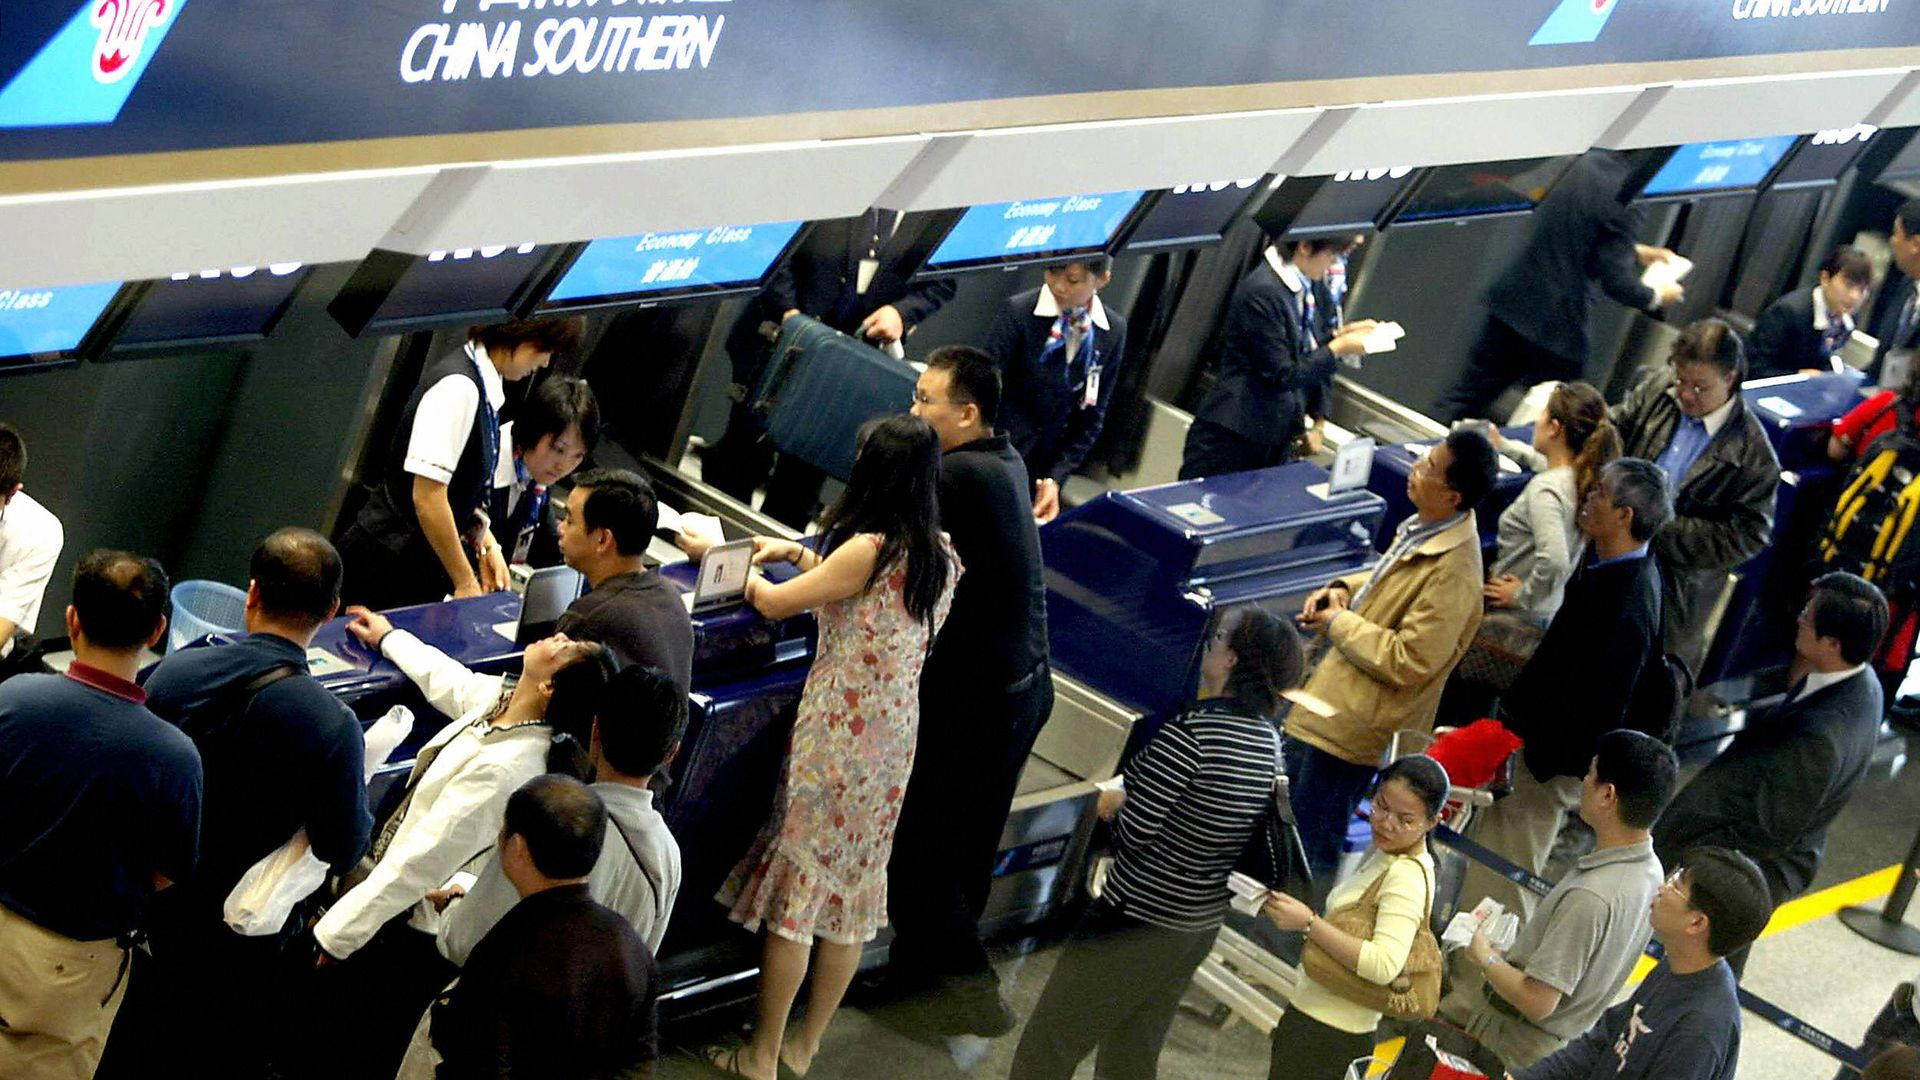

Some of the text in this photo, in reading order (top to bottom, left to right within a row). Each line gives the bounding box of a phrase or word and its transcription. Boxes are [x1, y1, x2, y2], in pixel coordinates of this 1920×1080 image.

[401, 15, 726, 83] CHINA SOUTHERN
[1004, 196, 1102, 219] Economy Class
[637, 226, 752, 251] Economy Class
[0, 289, 53, 310] Class
